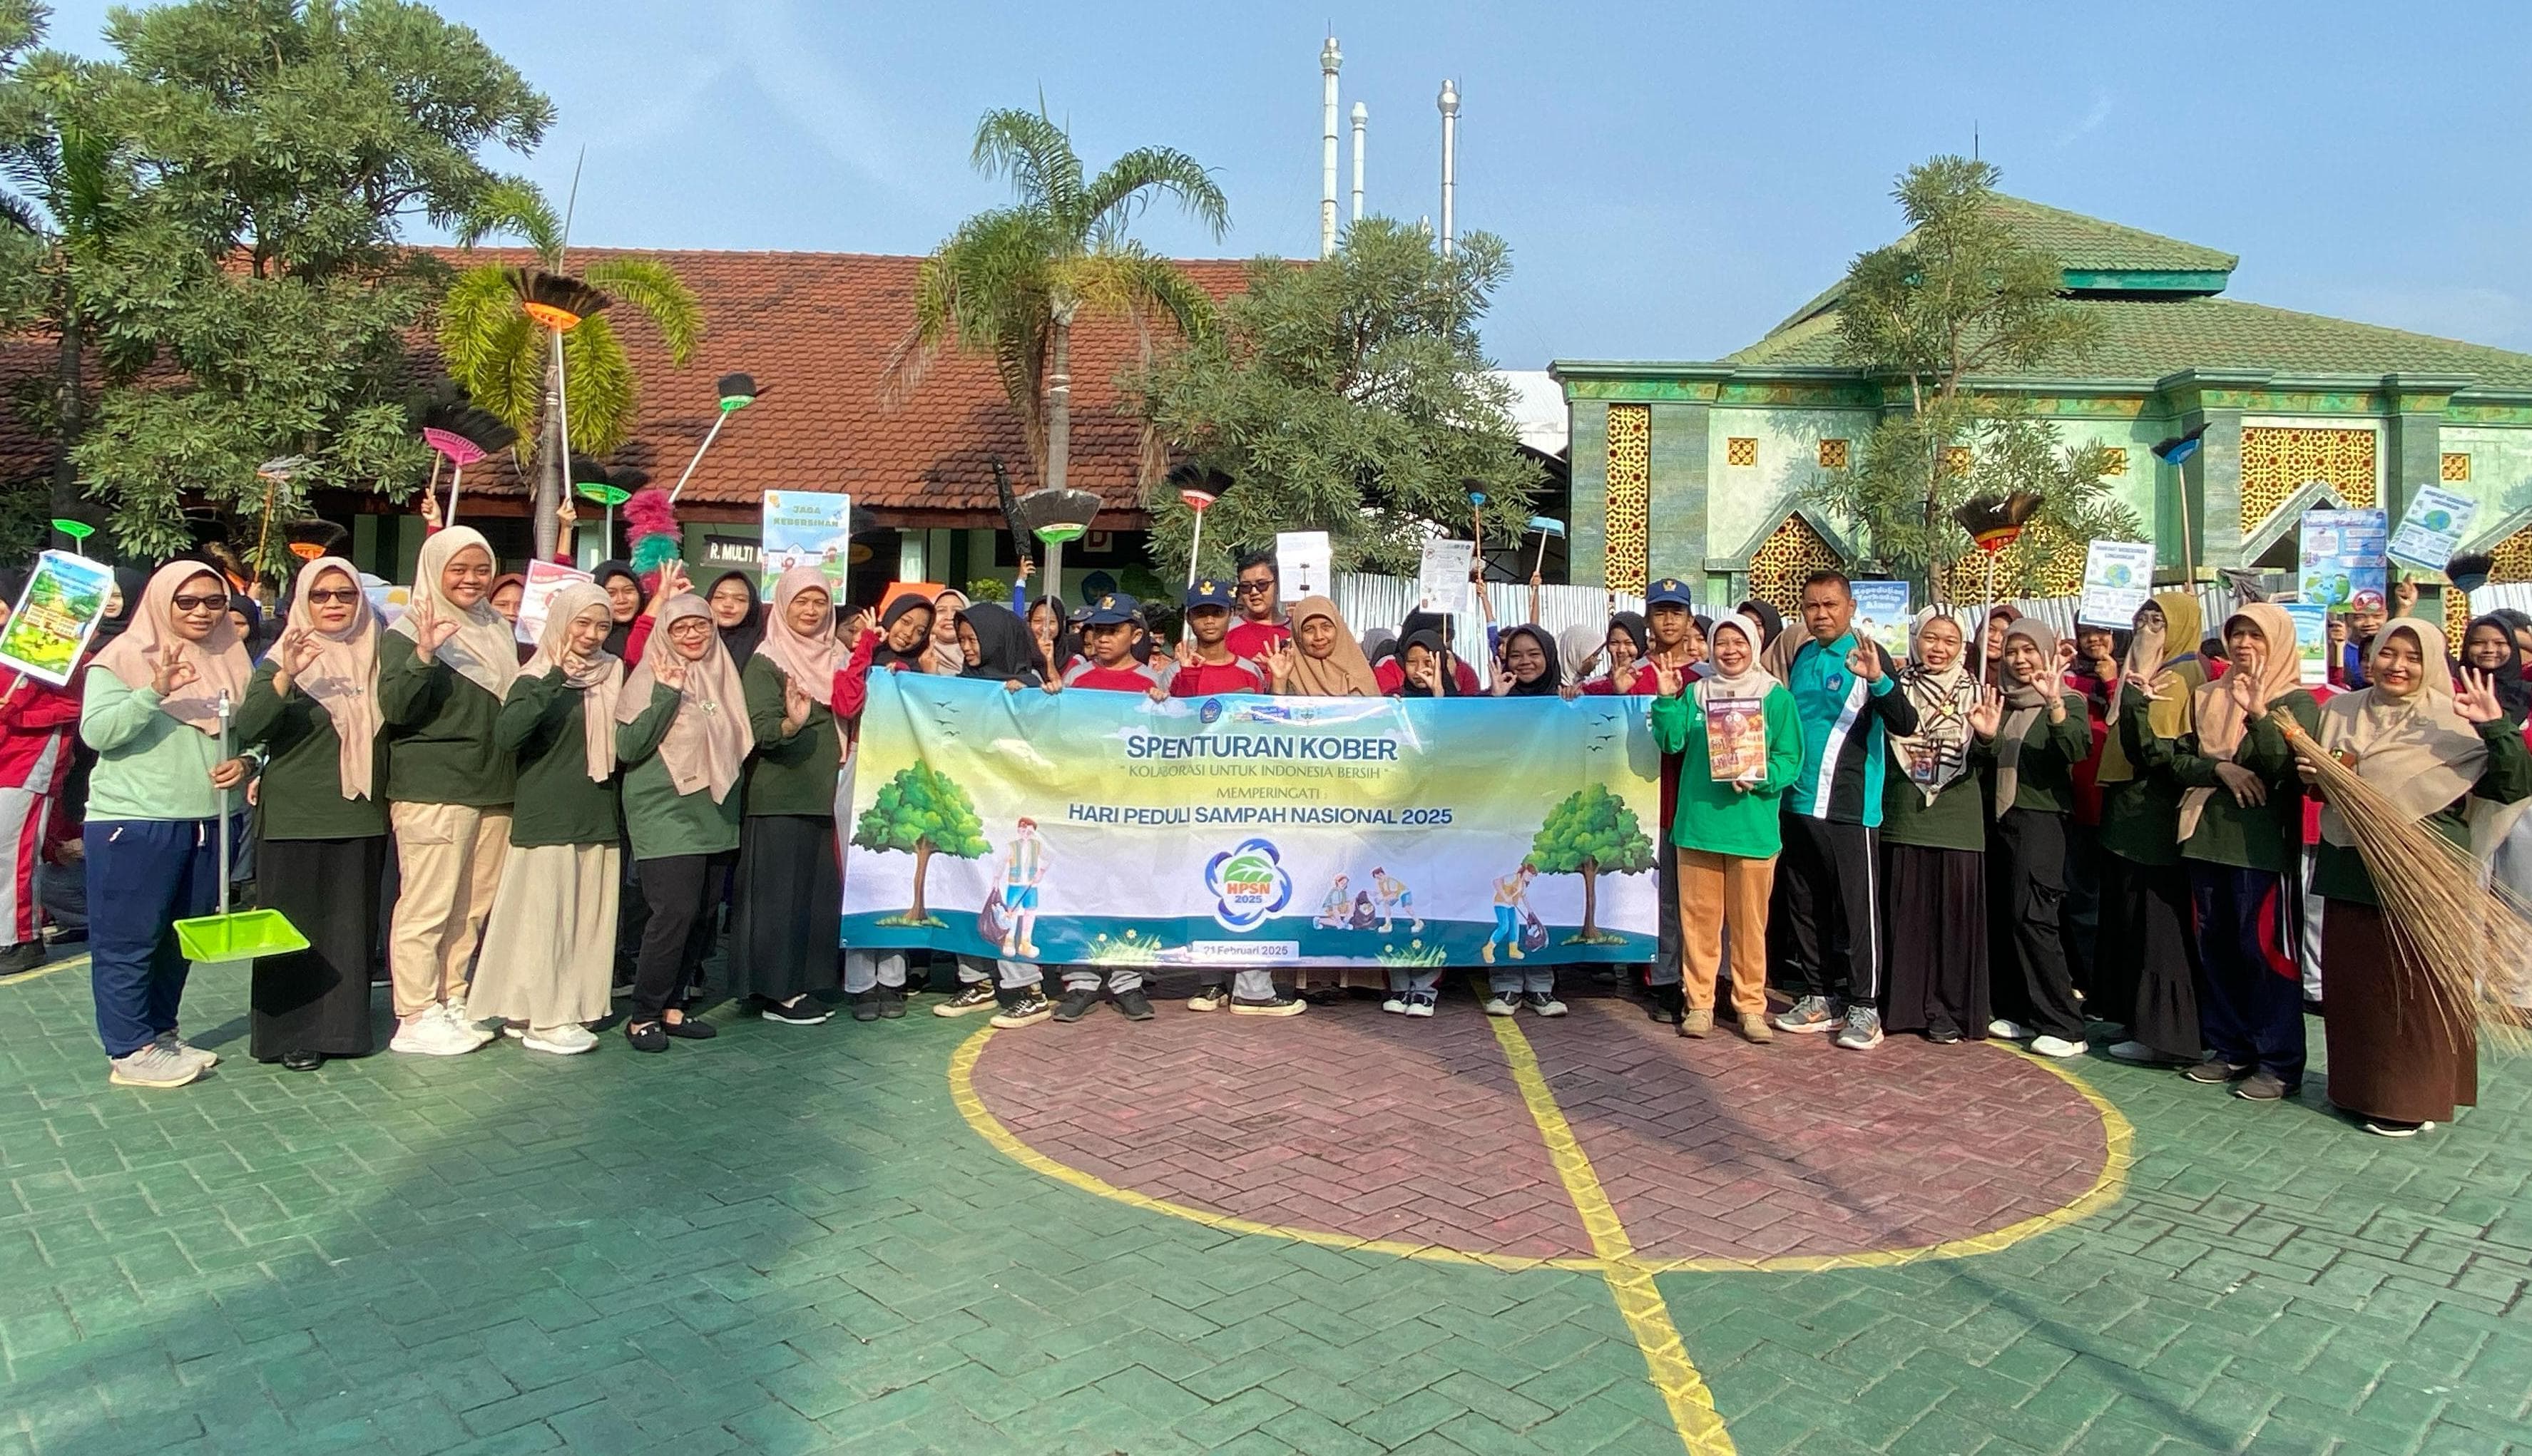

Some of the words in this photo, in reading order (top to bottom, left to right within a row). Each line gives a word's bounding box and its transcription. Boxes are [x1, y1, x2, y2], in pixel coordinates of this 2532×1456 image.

[710, 542, 720, 560] R.
[722, 543, 754, 563] MULTI
[1127, 735, 1293, 759] SPENTURAN
[1300, 737, 1398, 760] KOBER
[1129, 764, 1205, 778] KOLABORASI
[1210, 764, 1257, 776] UNTUK
[1262, 765, 1333, 778] INDONESIA
[1337, 766, 1380, 779] BERSIH
[1216, 786, 1320, 800] MEMPERINGATI
[1069, 804, 1119, 823] HARI
[1124, 807, 1190, 825] PEDULI
[1195, 806, 1287, 824] SAMPAH
[1291, 807, 1397, 824] NASIONAL
[1402, 809, 1453, 824] 2025
[1227, 883, 1270, 895] HPSN
[1235, 895, 1262, 903] 2025
[1217, 945, 1259, 955] Februari
[1262, 946, 1288, 955] 2025
